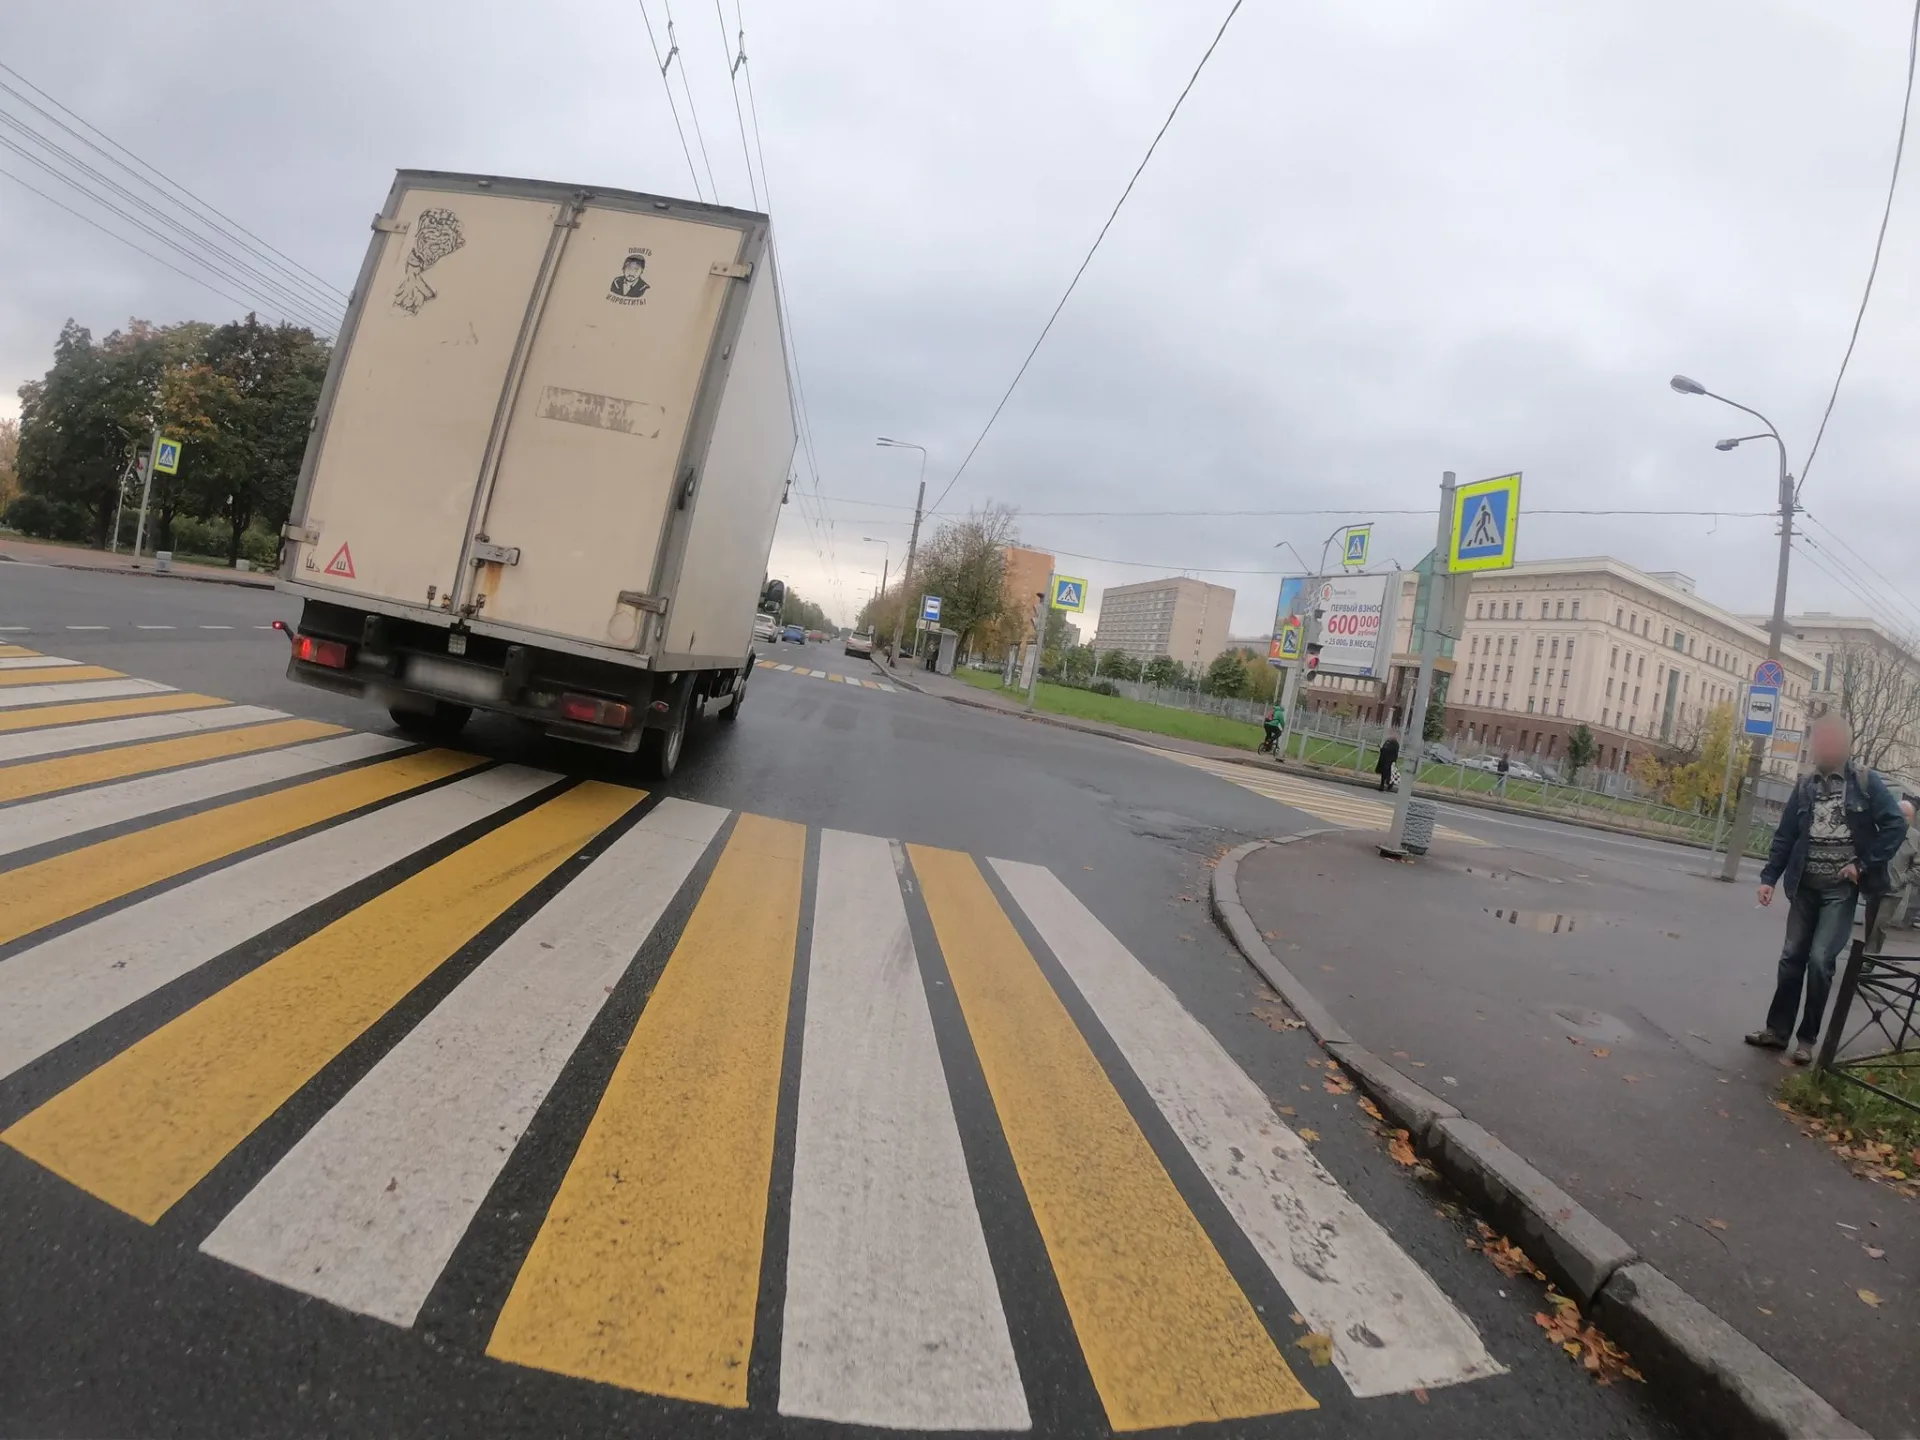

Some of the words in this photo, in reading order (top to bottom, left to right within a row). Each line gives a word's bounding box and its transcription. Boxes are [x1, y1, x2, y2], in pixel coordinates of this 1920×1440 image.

[336, 560, 346, 570] Ш
[1330, 603, 1358, 613] ПЕРВЫЙ
[1358, 604, 1382, 613] ВЗНОС
[1328, 614, 1358, 635] 600
[1359, 615, 1380, 628] 000
[1354, 639, 1375, 649] МЕСЯЦ
